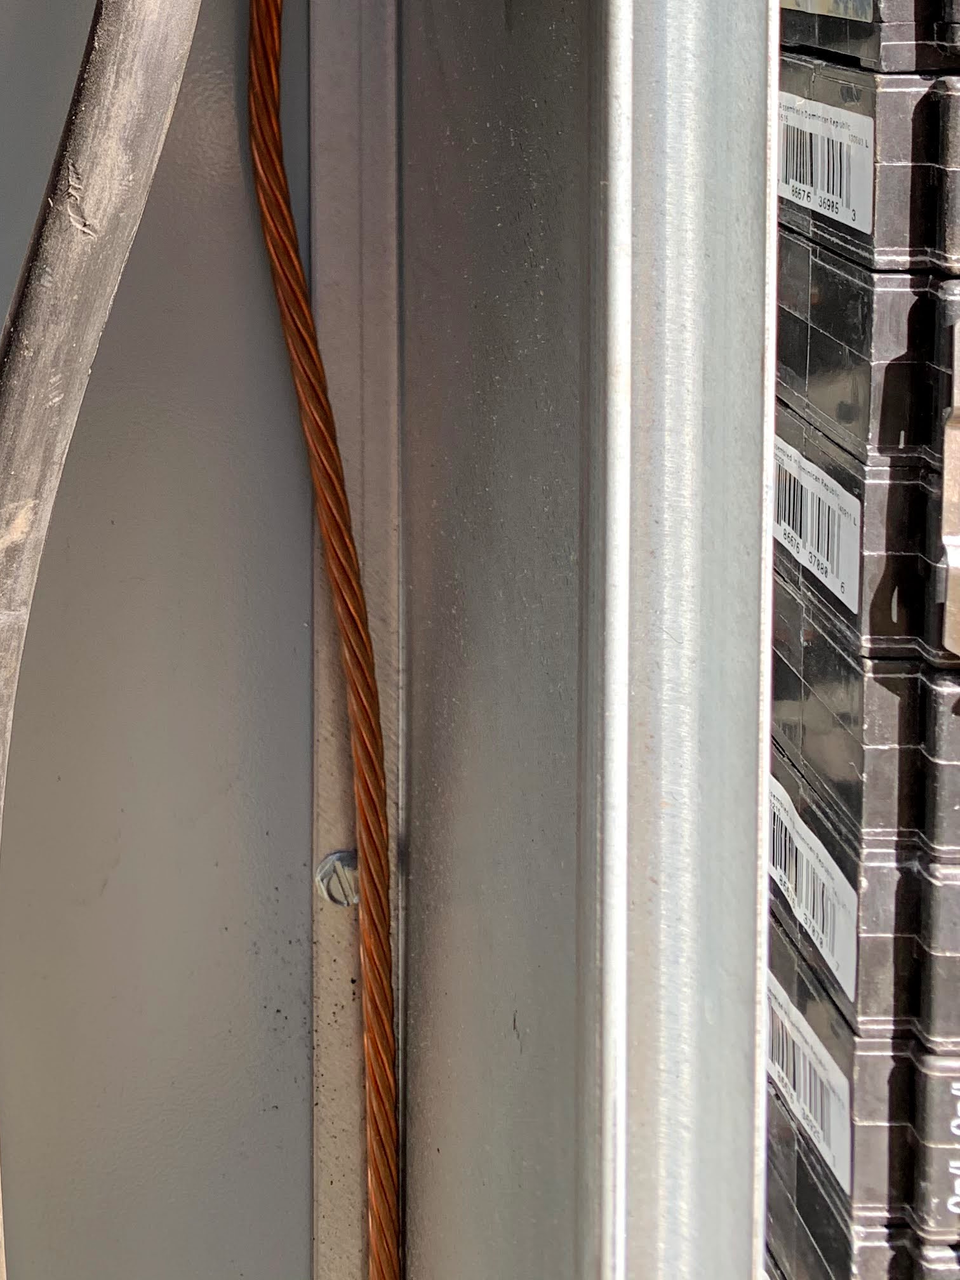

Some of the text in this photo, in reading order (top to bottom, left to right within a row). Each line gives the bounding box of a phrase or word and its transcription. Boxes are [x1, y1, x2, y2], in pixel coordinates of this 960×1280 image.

[791, 185, 811, 204] 86676
[851, 209, 856, 222] 3
[840, 580, 845, 595] 6
